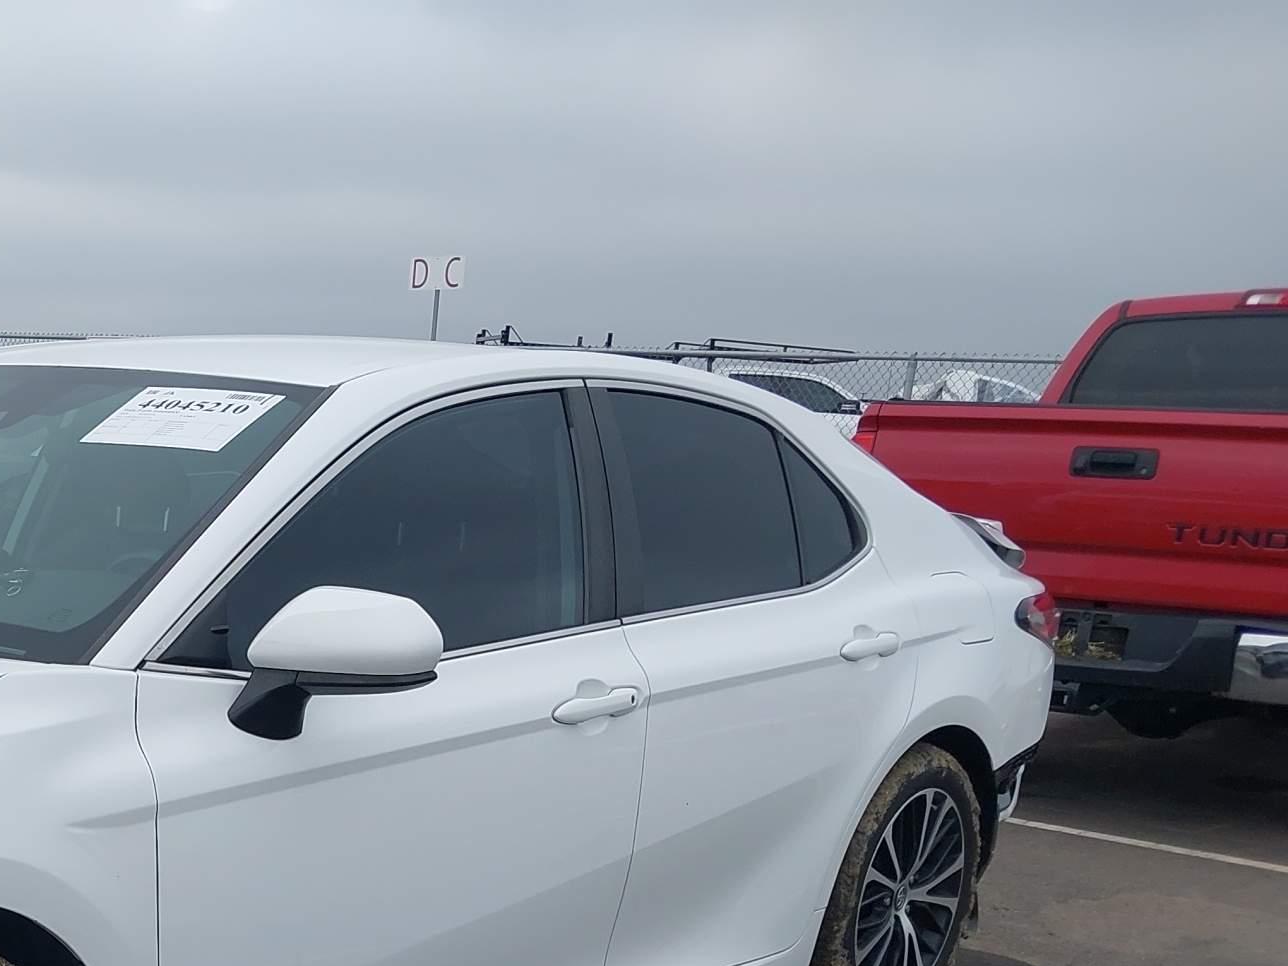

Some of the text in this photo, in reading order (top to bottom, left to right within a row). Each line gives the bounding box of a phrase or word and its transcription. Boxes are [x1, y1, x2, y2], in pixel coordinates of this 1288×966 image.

[412, 257, 461, 288] D C
[138, 399, 250, 415] 44045210
